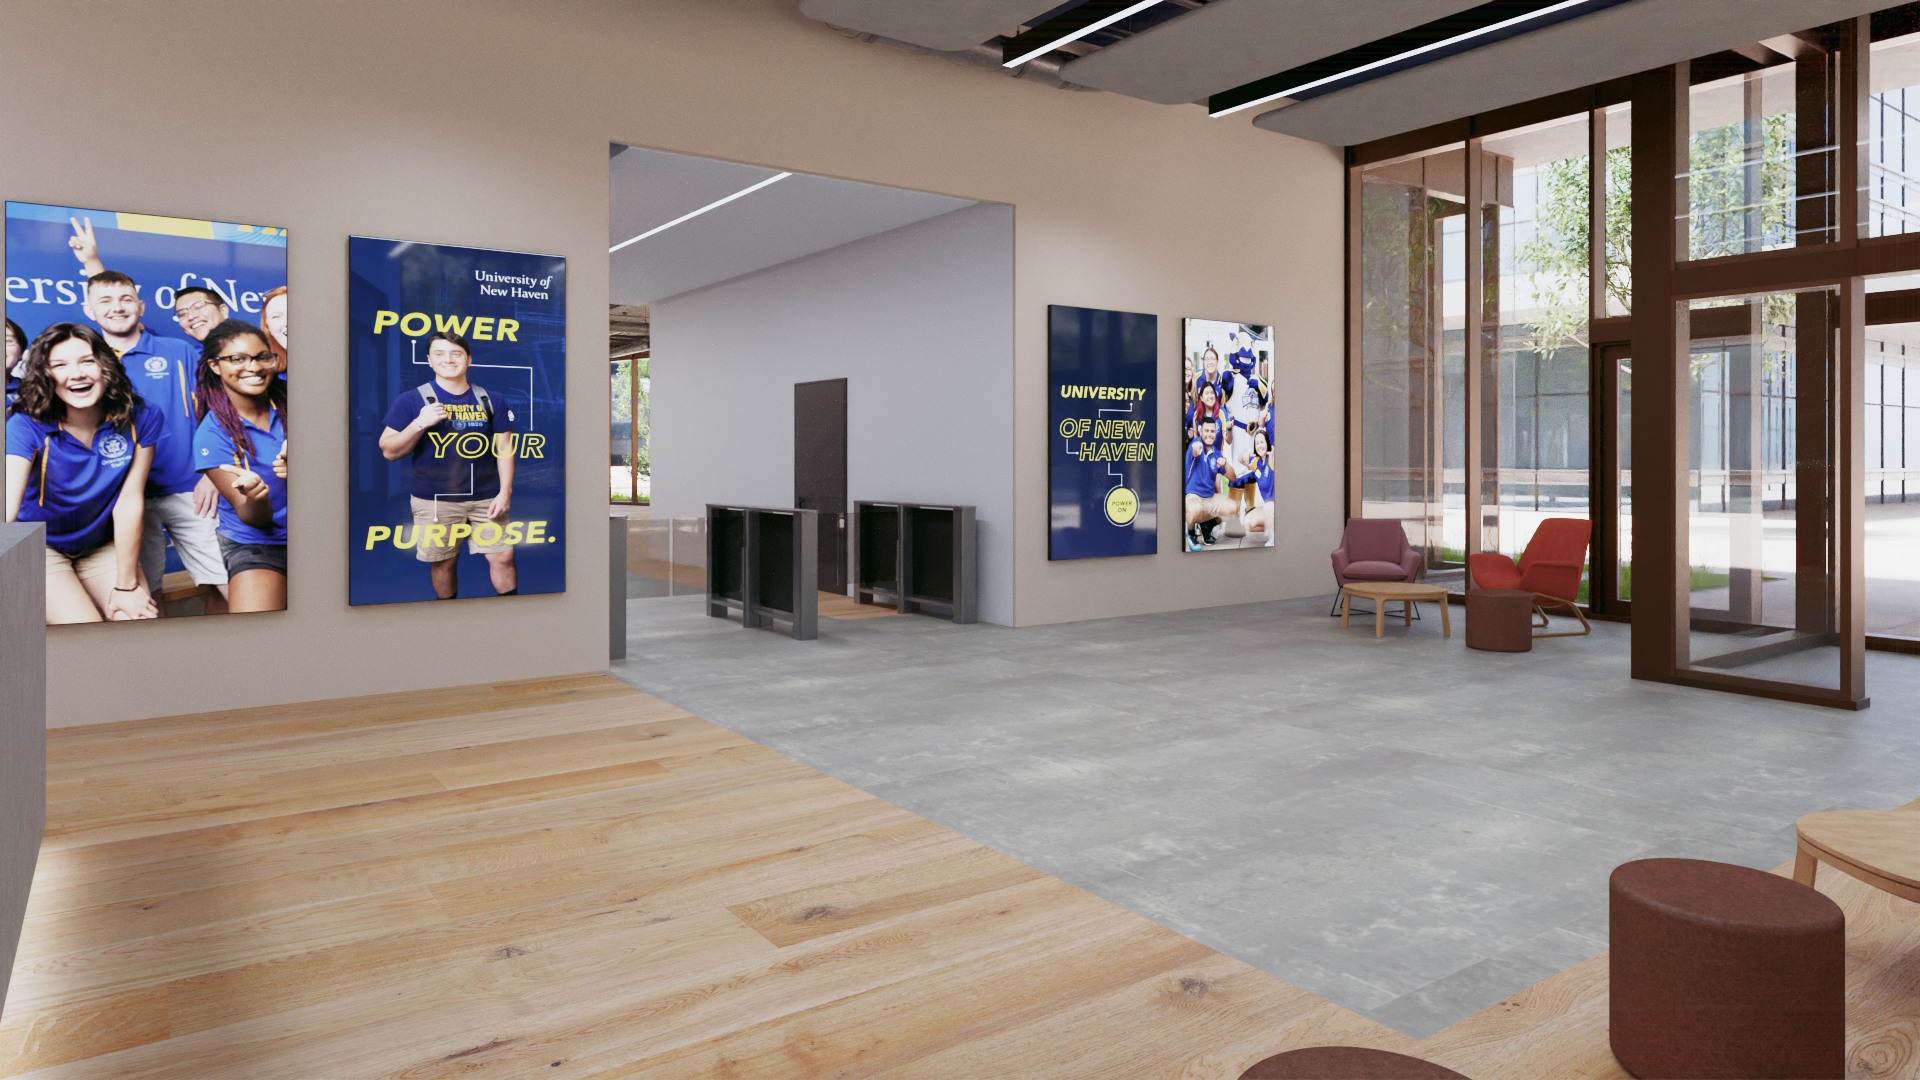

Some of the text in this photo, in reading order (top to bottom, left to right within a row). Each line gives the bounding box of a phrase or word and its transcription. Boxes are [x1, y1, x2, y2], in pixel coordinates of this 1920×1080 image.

[475, 270, 553, 289] University of
[6, 269, 142, 305] ersi
[202, 277, 267, 314] Ne
[480, 284, 548, 300] New Haven
[373, 310, 520, 342] POWER
[1061, 384, 1146, 401] UNIVERSITY
[1059, 418, 1146, 439] OF NEW
[428, 432, 546, 459] YOUR
[1079, 442, 1154, 461] HAVEN
[365, 520, 556, 551] PURPOSE.
